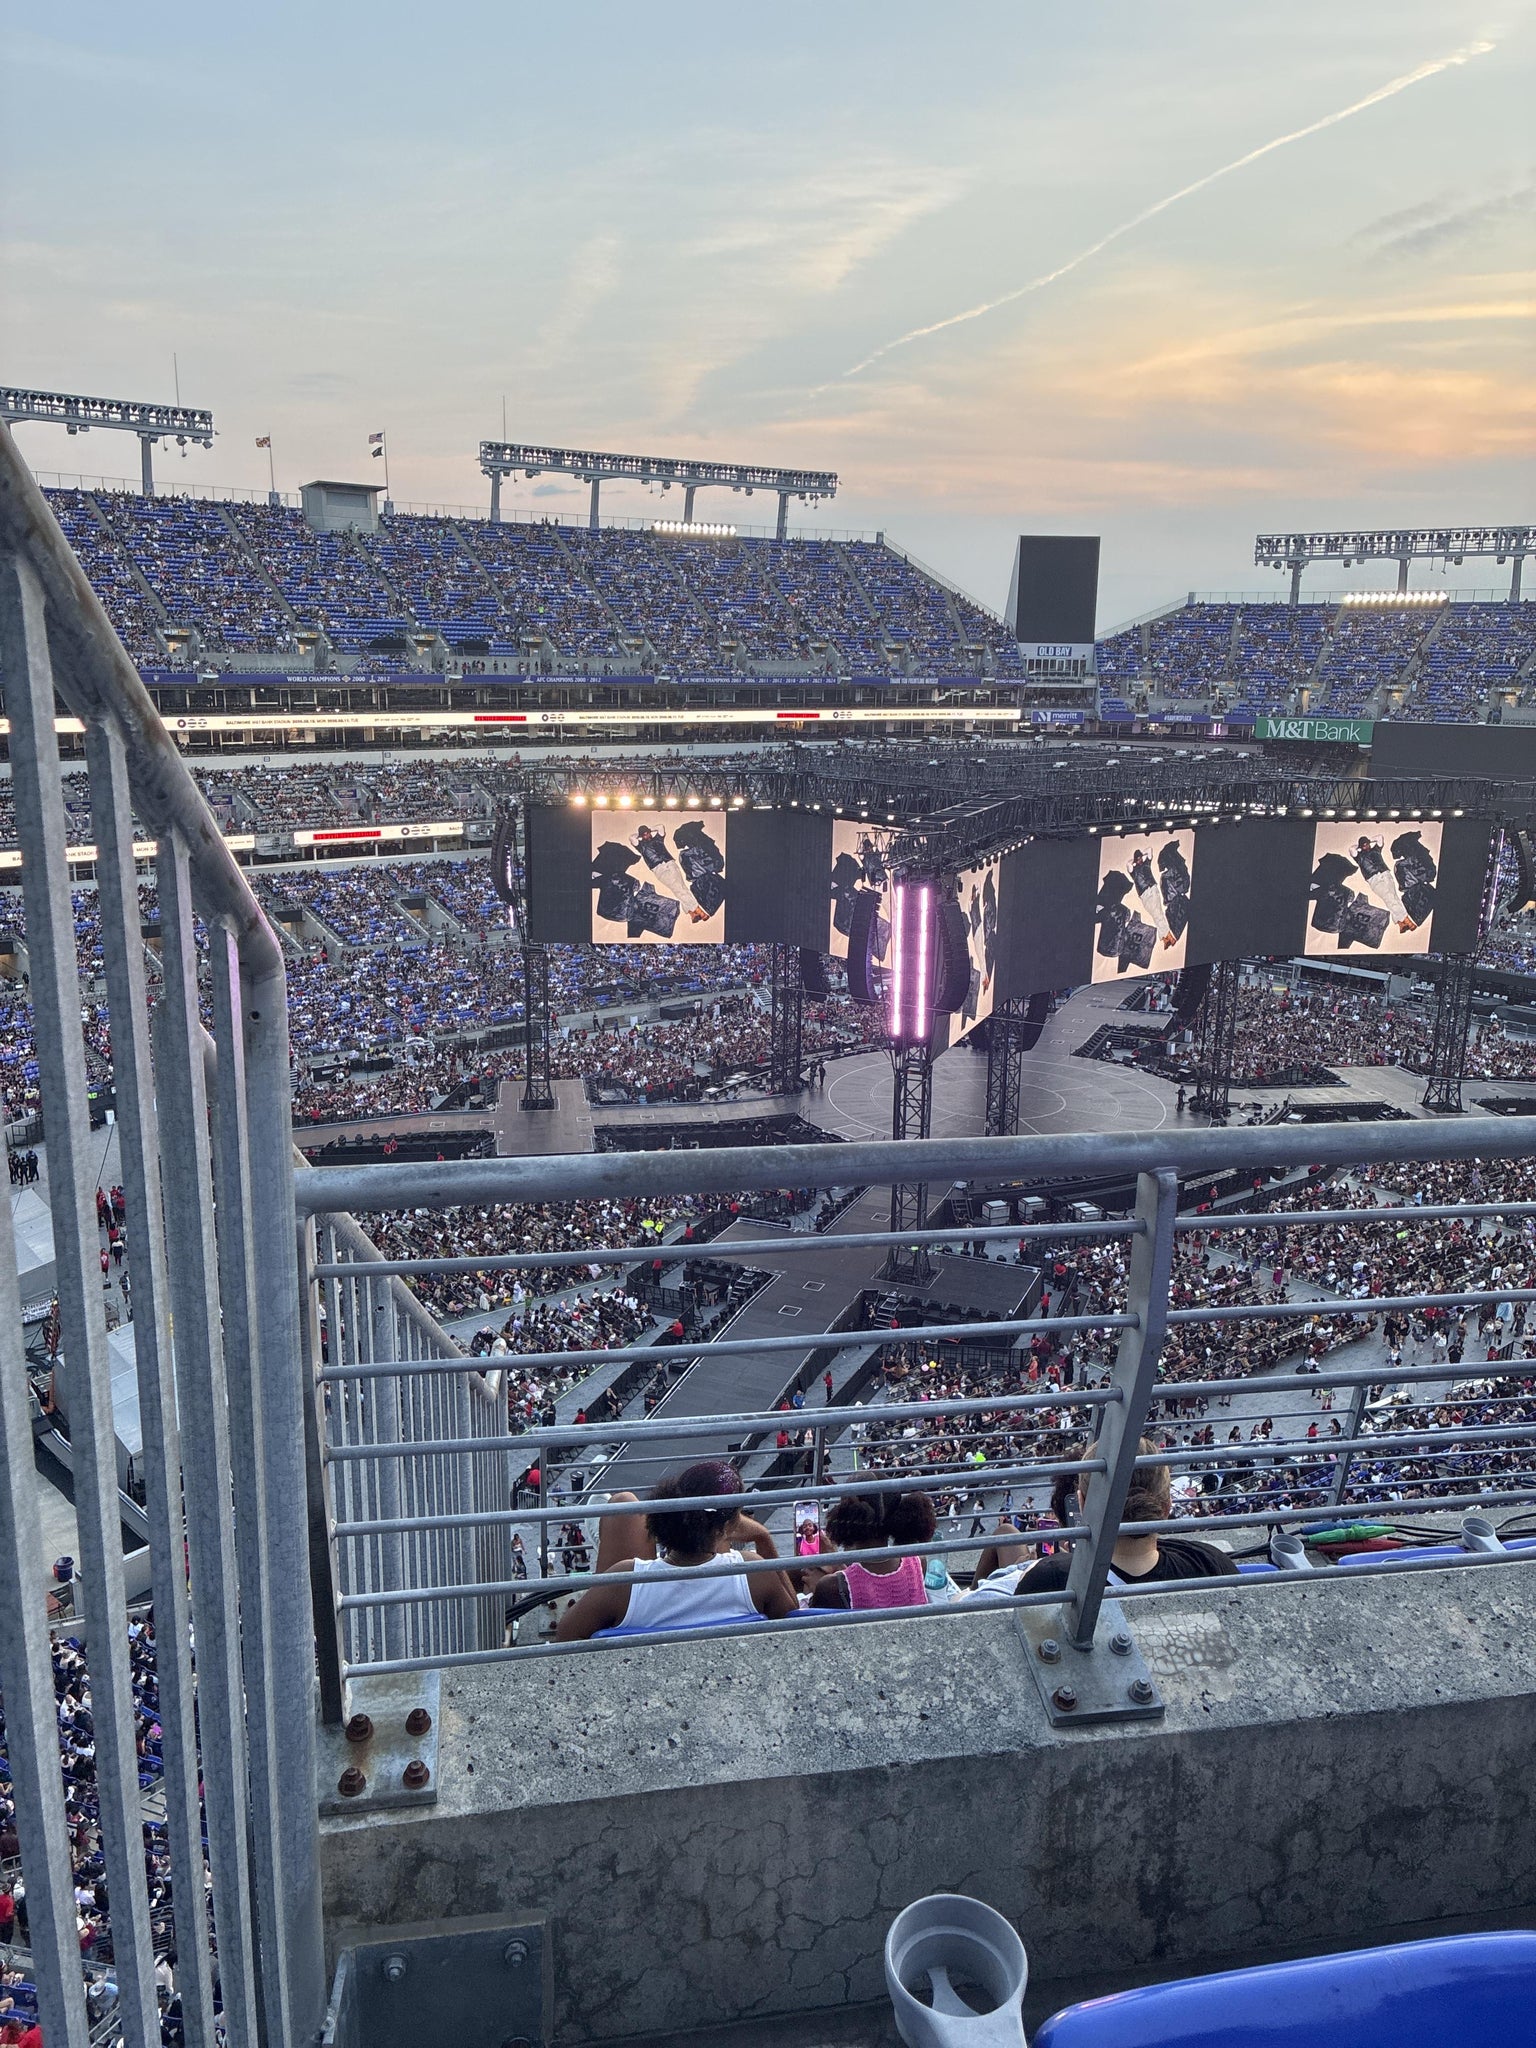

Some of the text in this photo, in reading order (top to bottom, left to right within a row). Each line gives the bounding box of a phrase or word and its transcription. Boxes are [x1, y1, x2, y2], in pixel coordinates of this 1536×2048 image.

[1039, 646, 1071, 656] OLD BAY
[1052, 712, 1078, 720] merritt
[1266, 719, 1361, 741] M&T Bank
